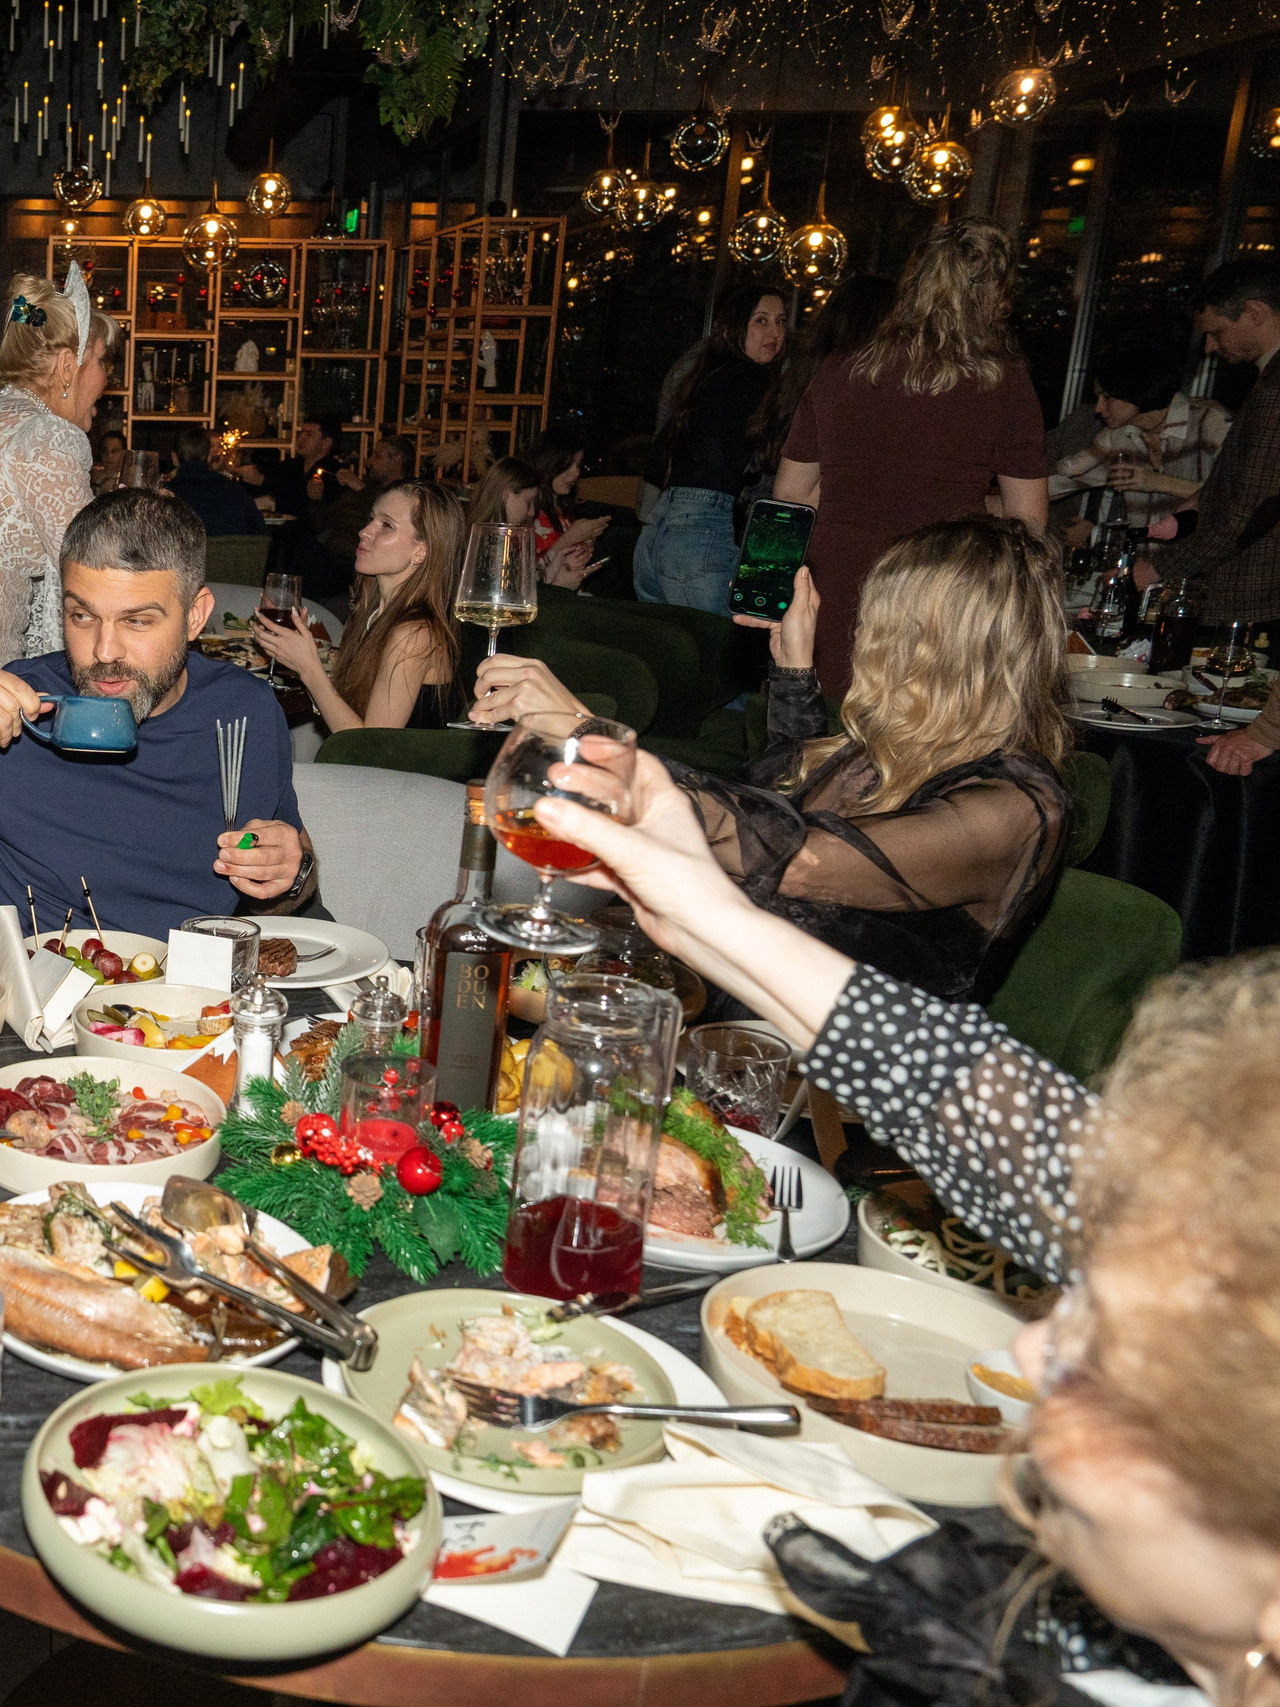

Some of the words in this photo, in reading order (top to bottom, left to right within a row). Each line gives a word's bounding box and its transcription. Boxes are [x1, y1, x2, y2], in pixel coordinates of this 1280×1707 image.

[459, 964, 490, 980] BO
[457, 979, 488, 995] DU
[456, 994, 486, 1010] EN
